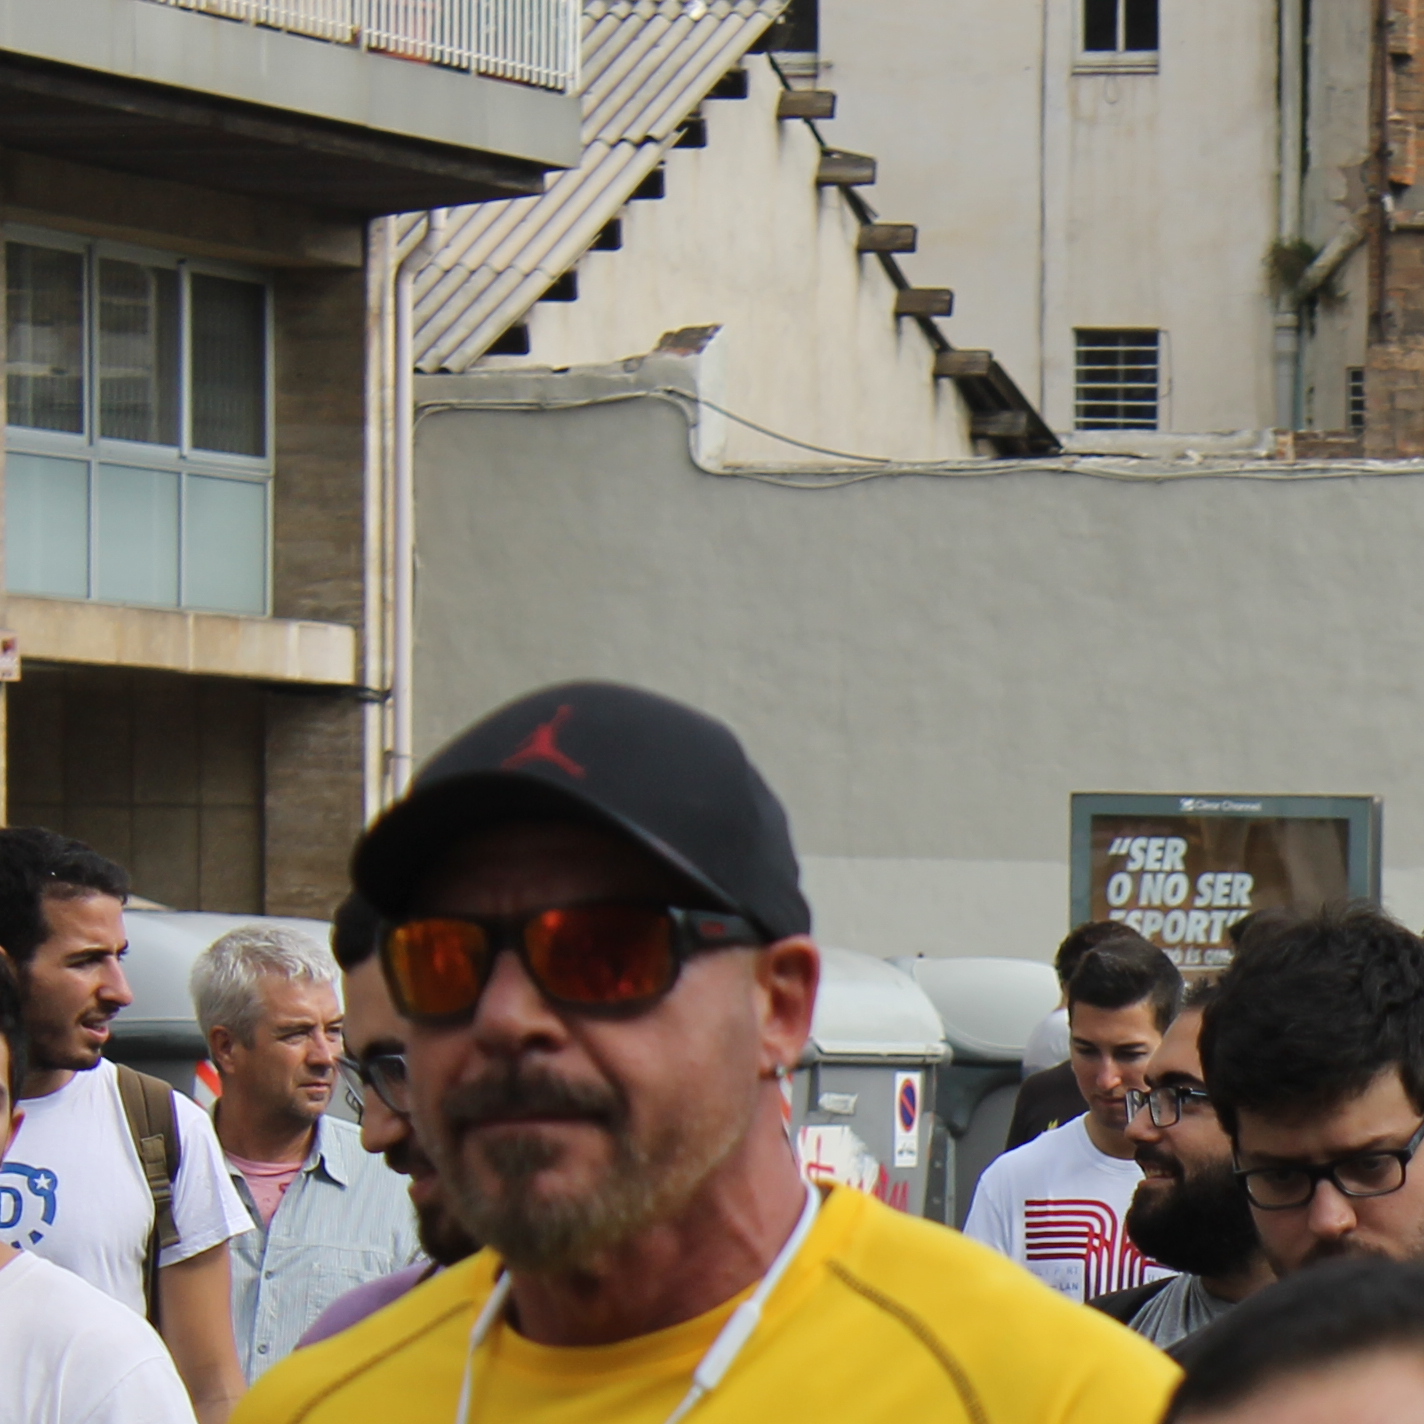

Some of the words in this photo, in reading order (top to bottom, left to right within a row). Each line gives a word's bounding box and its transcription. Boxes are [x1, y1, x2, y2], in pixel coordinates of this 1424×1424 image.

[1106, 871, 1133, 907] O
[1138, 871, 1190, 907] NO
[1193, 871, 1255, 907] SER
